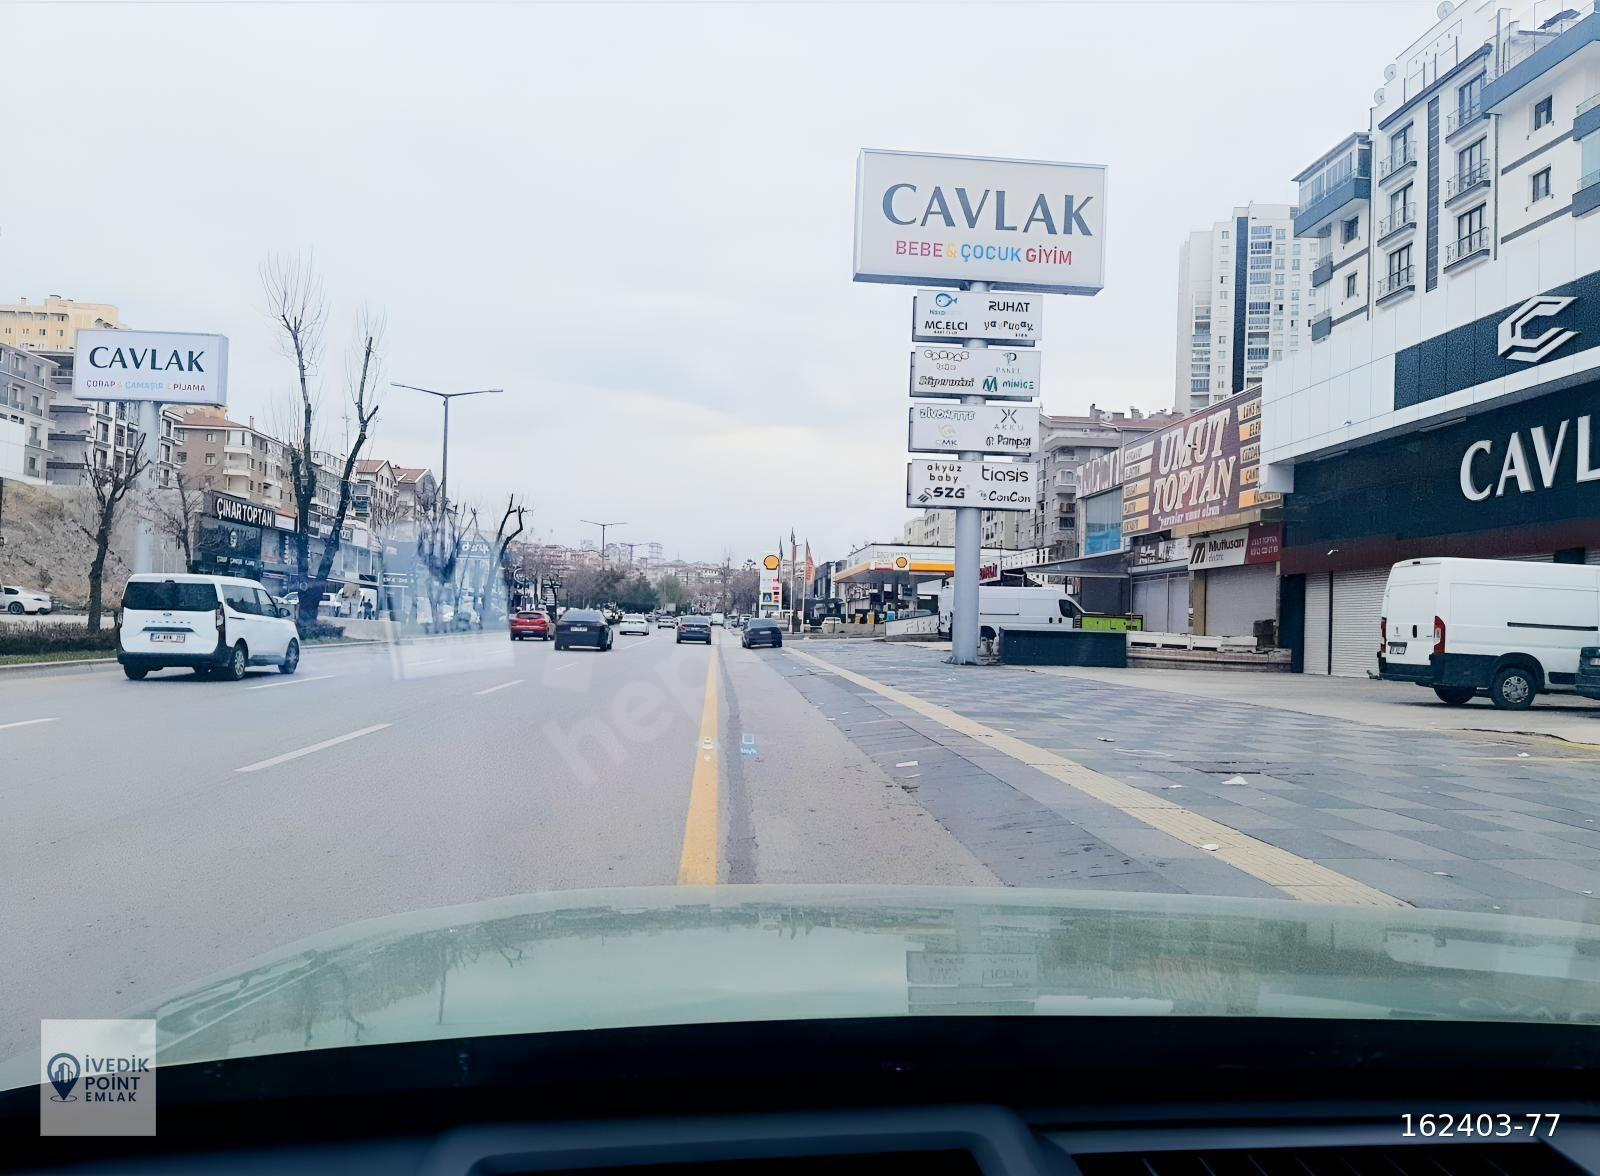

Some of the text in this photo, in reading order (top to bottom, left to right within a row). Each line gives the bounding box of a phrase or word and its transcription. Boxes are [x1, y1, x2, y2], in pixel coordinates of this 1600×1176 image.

[882, 183, 1094, 236] CAVLAK
[896, 240, 1072, 265] BEBE & ÇOCUK GİYİM
[988, 300, 1031, 312] RUHAT
[925, 320, 968, 331] MC.ELCI
[89, 346, 205, 372] CAVLAK
[1159, 409, 1230, 474] UMUT
[926, 463, 962, 474] akyüz
[929, 472, 959, 484] baby
[981, 464, 1029, 483] tiasis
[932, 486, 966, 499] SZG
[1153, 456, 1236, 515] TOPTAN
[988, 490, 1031, 503] ConCon
[216, 497, 273, 527] ÇINAR TOPTAN
